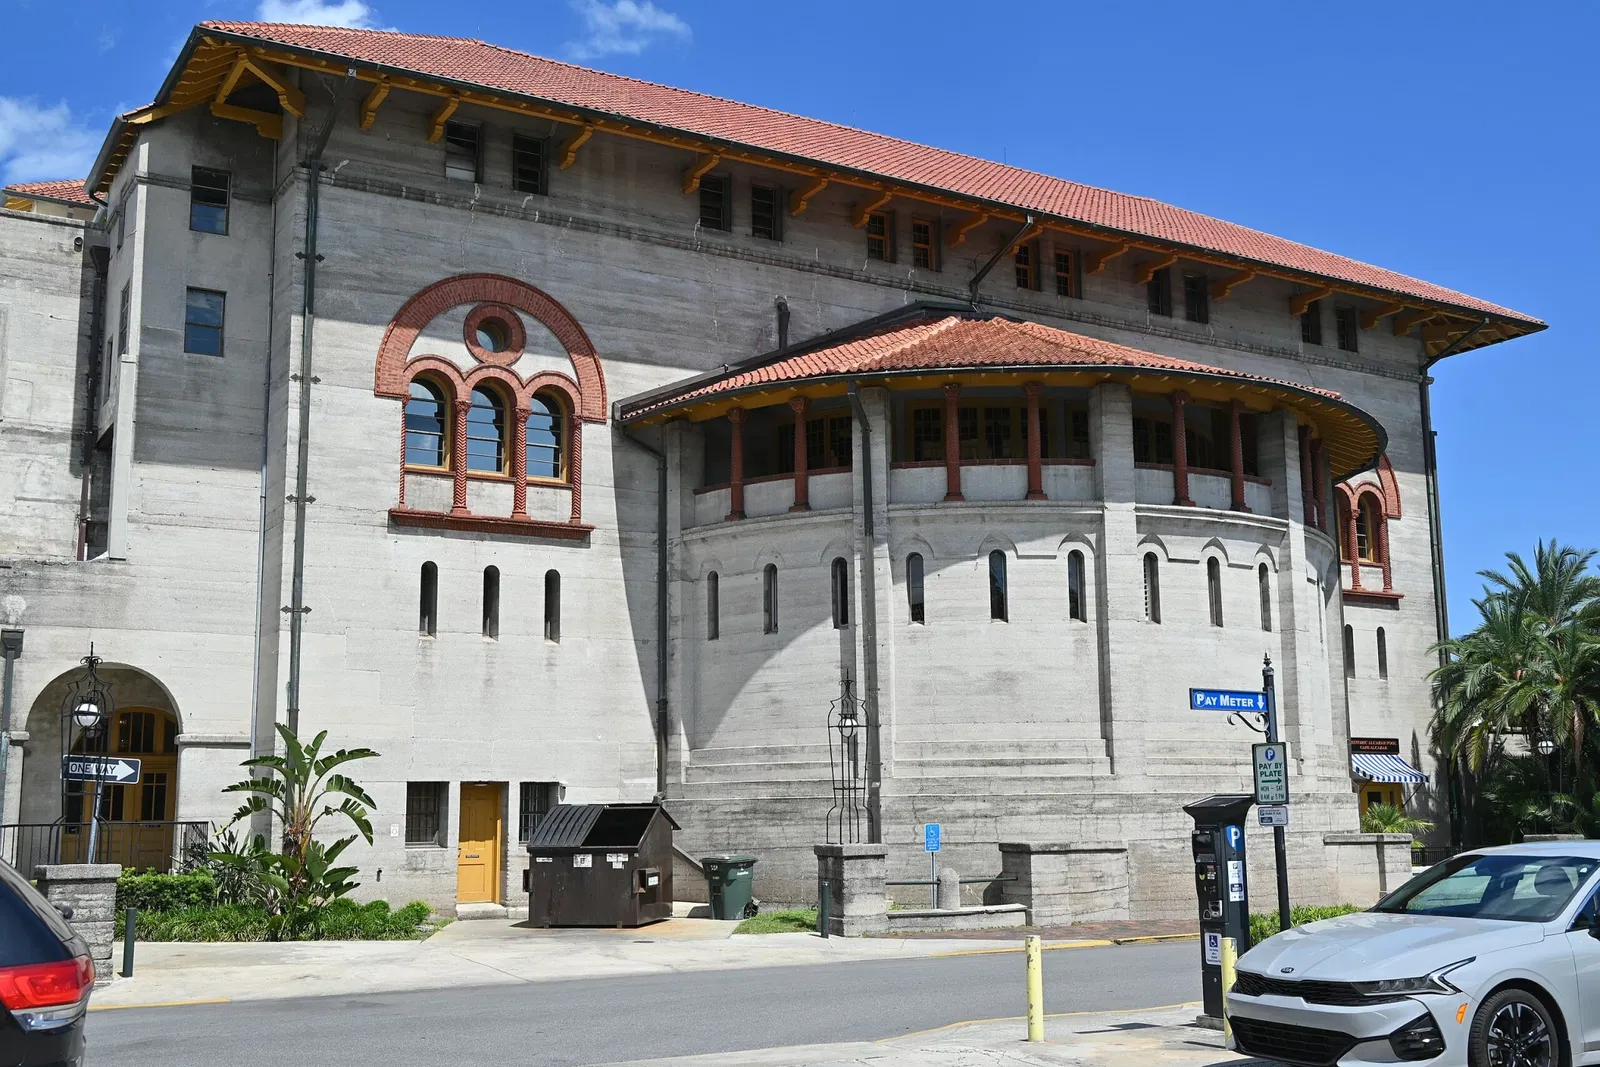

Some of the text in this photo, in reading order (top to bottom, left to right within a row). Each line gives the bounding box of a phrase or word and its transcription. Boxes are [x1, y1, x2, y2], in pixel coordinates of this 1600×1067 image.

[1196, 693, 1254, 707] PAY METER
[70, 763, 116, 775] ONE WAY
